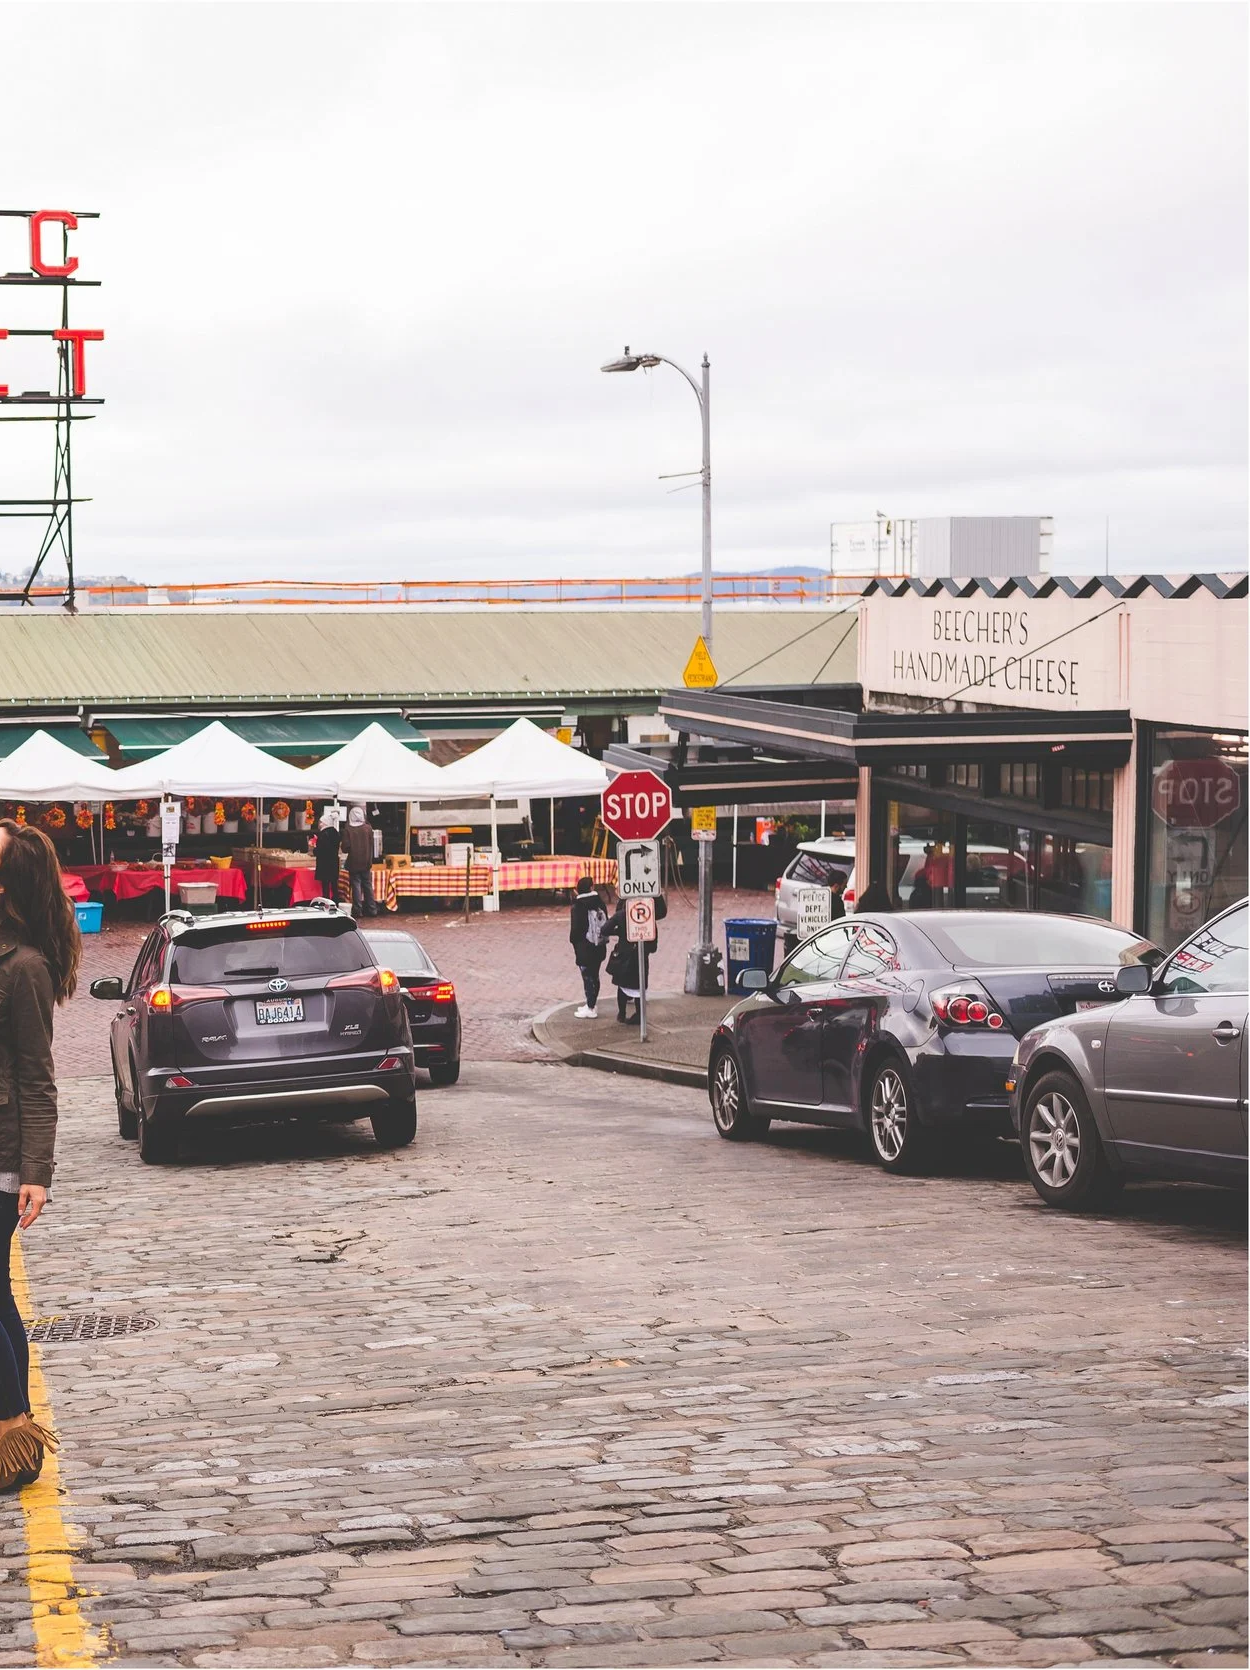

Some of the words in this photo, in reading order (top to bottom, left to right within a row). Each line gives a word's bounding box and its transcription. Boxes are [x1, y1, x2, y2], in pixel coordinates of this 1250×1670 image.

[933, 610, 1028, 646] BEECHER'S
[893, 650, 996, 688] HANDMADE
[1004, 656, 1079, 696] CHEESE
[606, 791, 667, 820] STOP
[623, 881, 657, 895] ONLY
[800, 915, 828, 923] VEHICLES
[258, 1006, 302, 1021] BAJ6414
